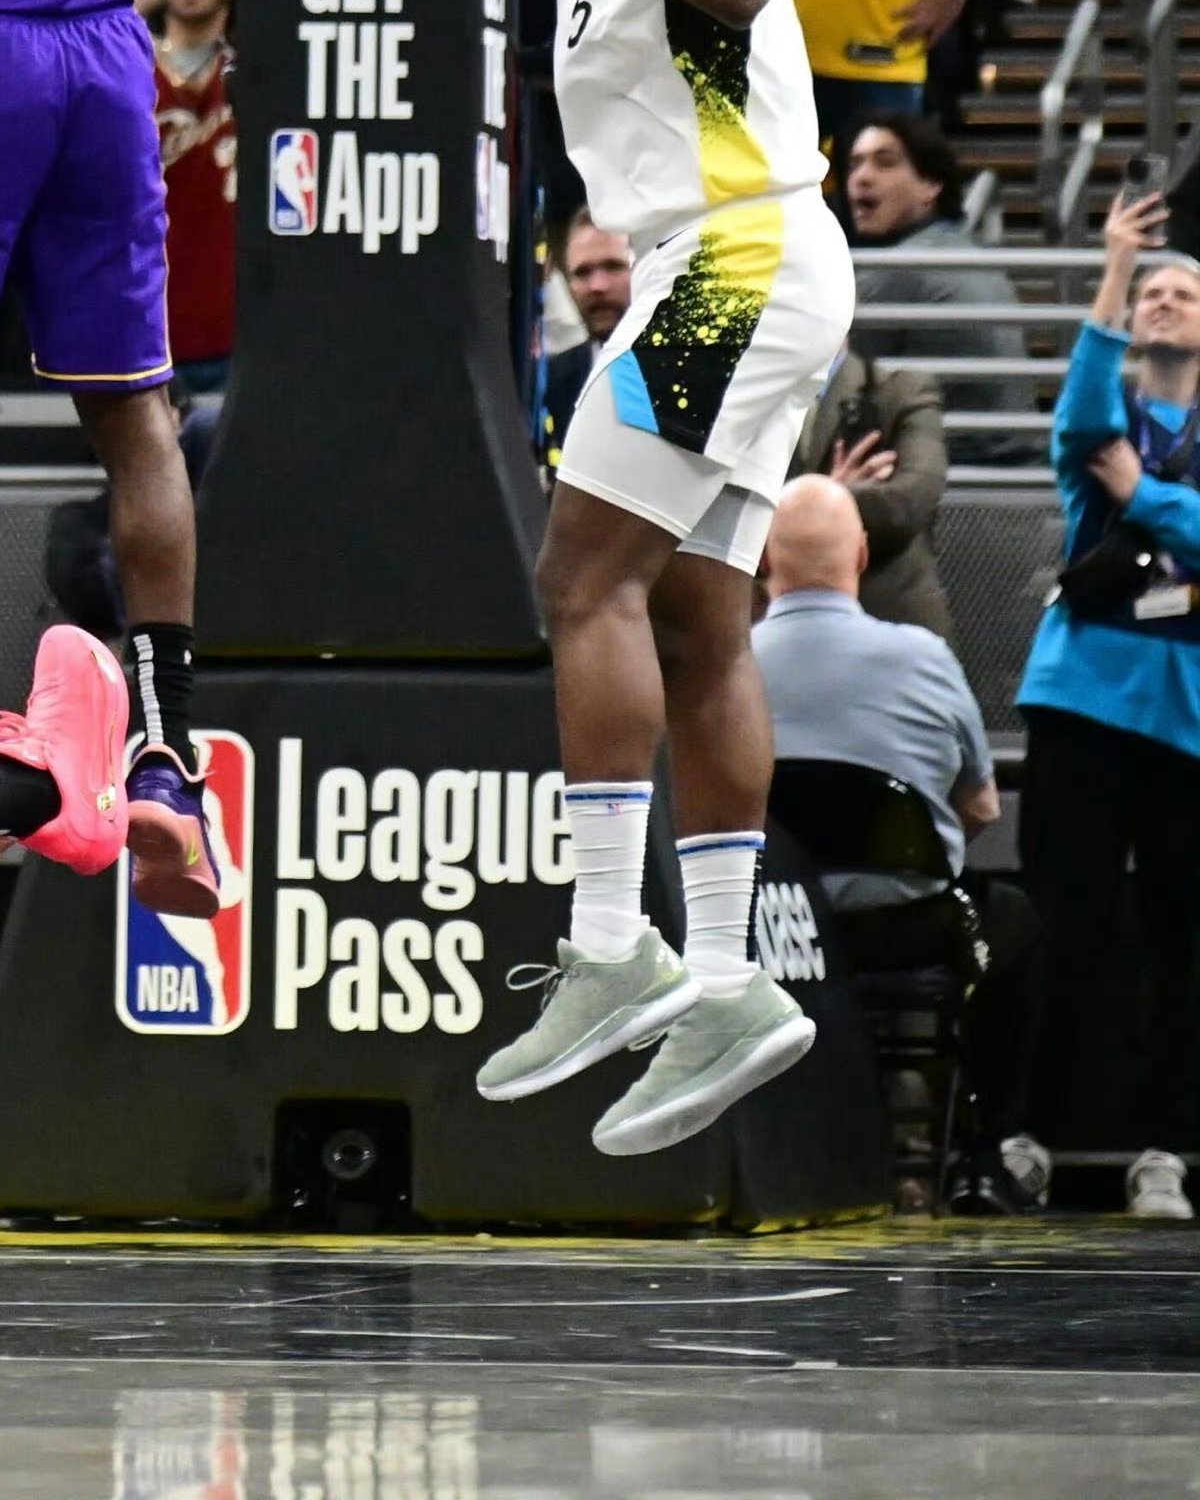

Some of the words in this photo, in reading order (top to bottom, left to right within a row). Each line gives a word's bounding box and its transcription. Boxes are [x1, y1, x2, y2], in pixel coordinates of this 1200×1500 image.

[298, 21, 416, 121] THE
[321, 130, 441, 254] App
[276, 737, 576, 912] League
[137, 965, 200, 1014] NBA
[273, 887, 485, 1035] Pass
